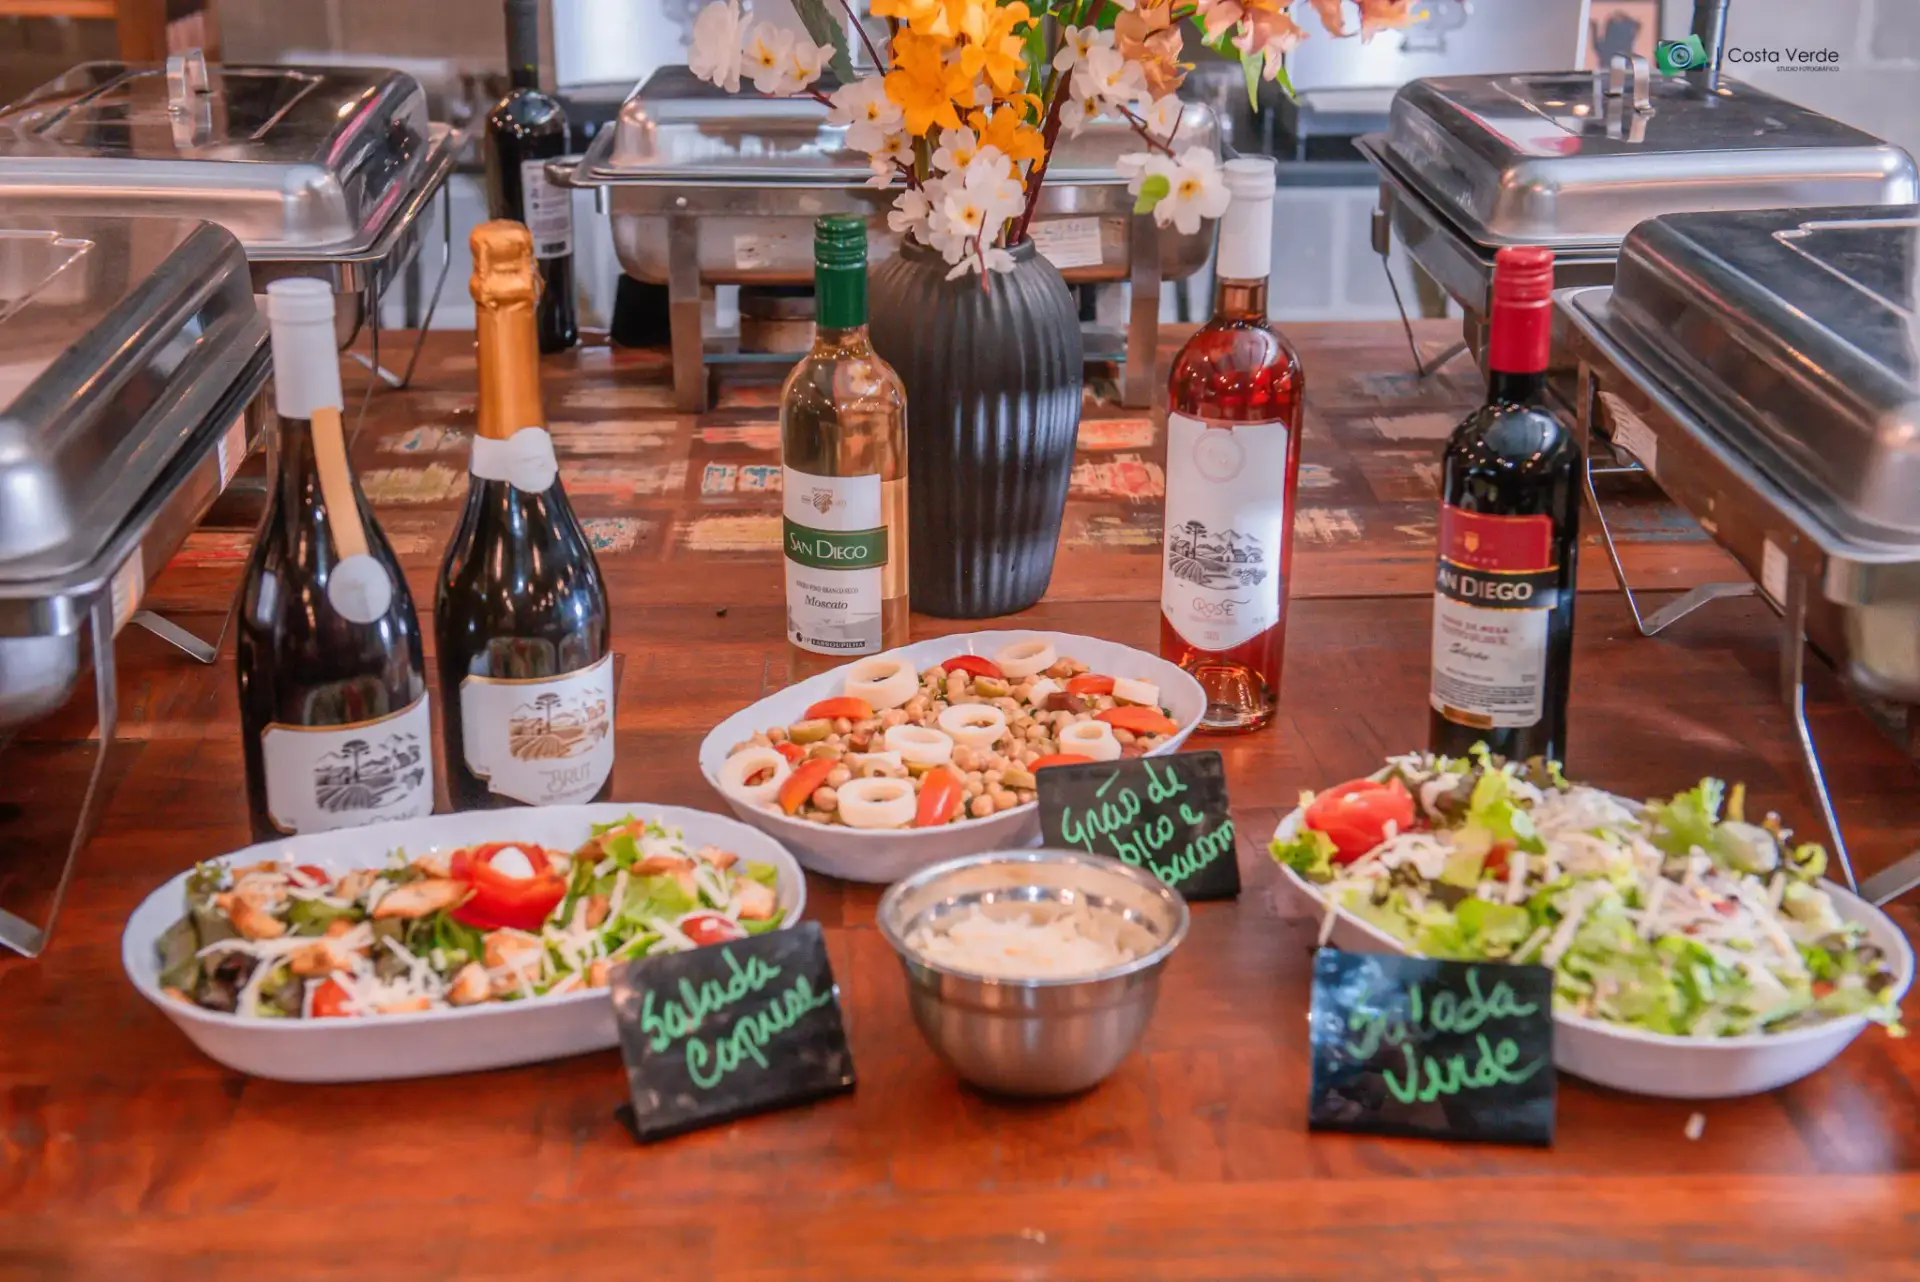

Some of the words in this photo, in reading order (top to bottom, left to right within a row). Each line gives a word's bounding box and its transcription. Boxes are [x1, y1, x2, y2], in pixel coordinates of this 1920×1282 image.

[789, 532, 813, 557] SAN
[816, 539, 868, 561] DIEGO
[1460, 575, 1533, 601] DIEGO
[805, 594, 849, 610] Moscato
[1143, 760, 1188, 803] de
[1179, 803, 1204, 825] e
[641, 947, 782, 1053] Salada
